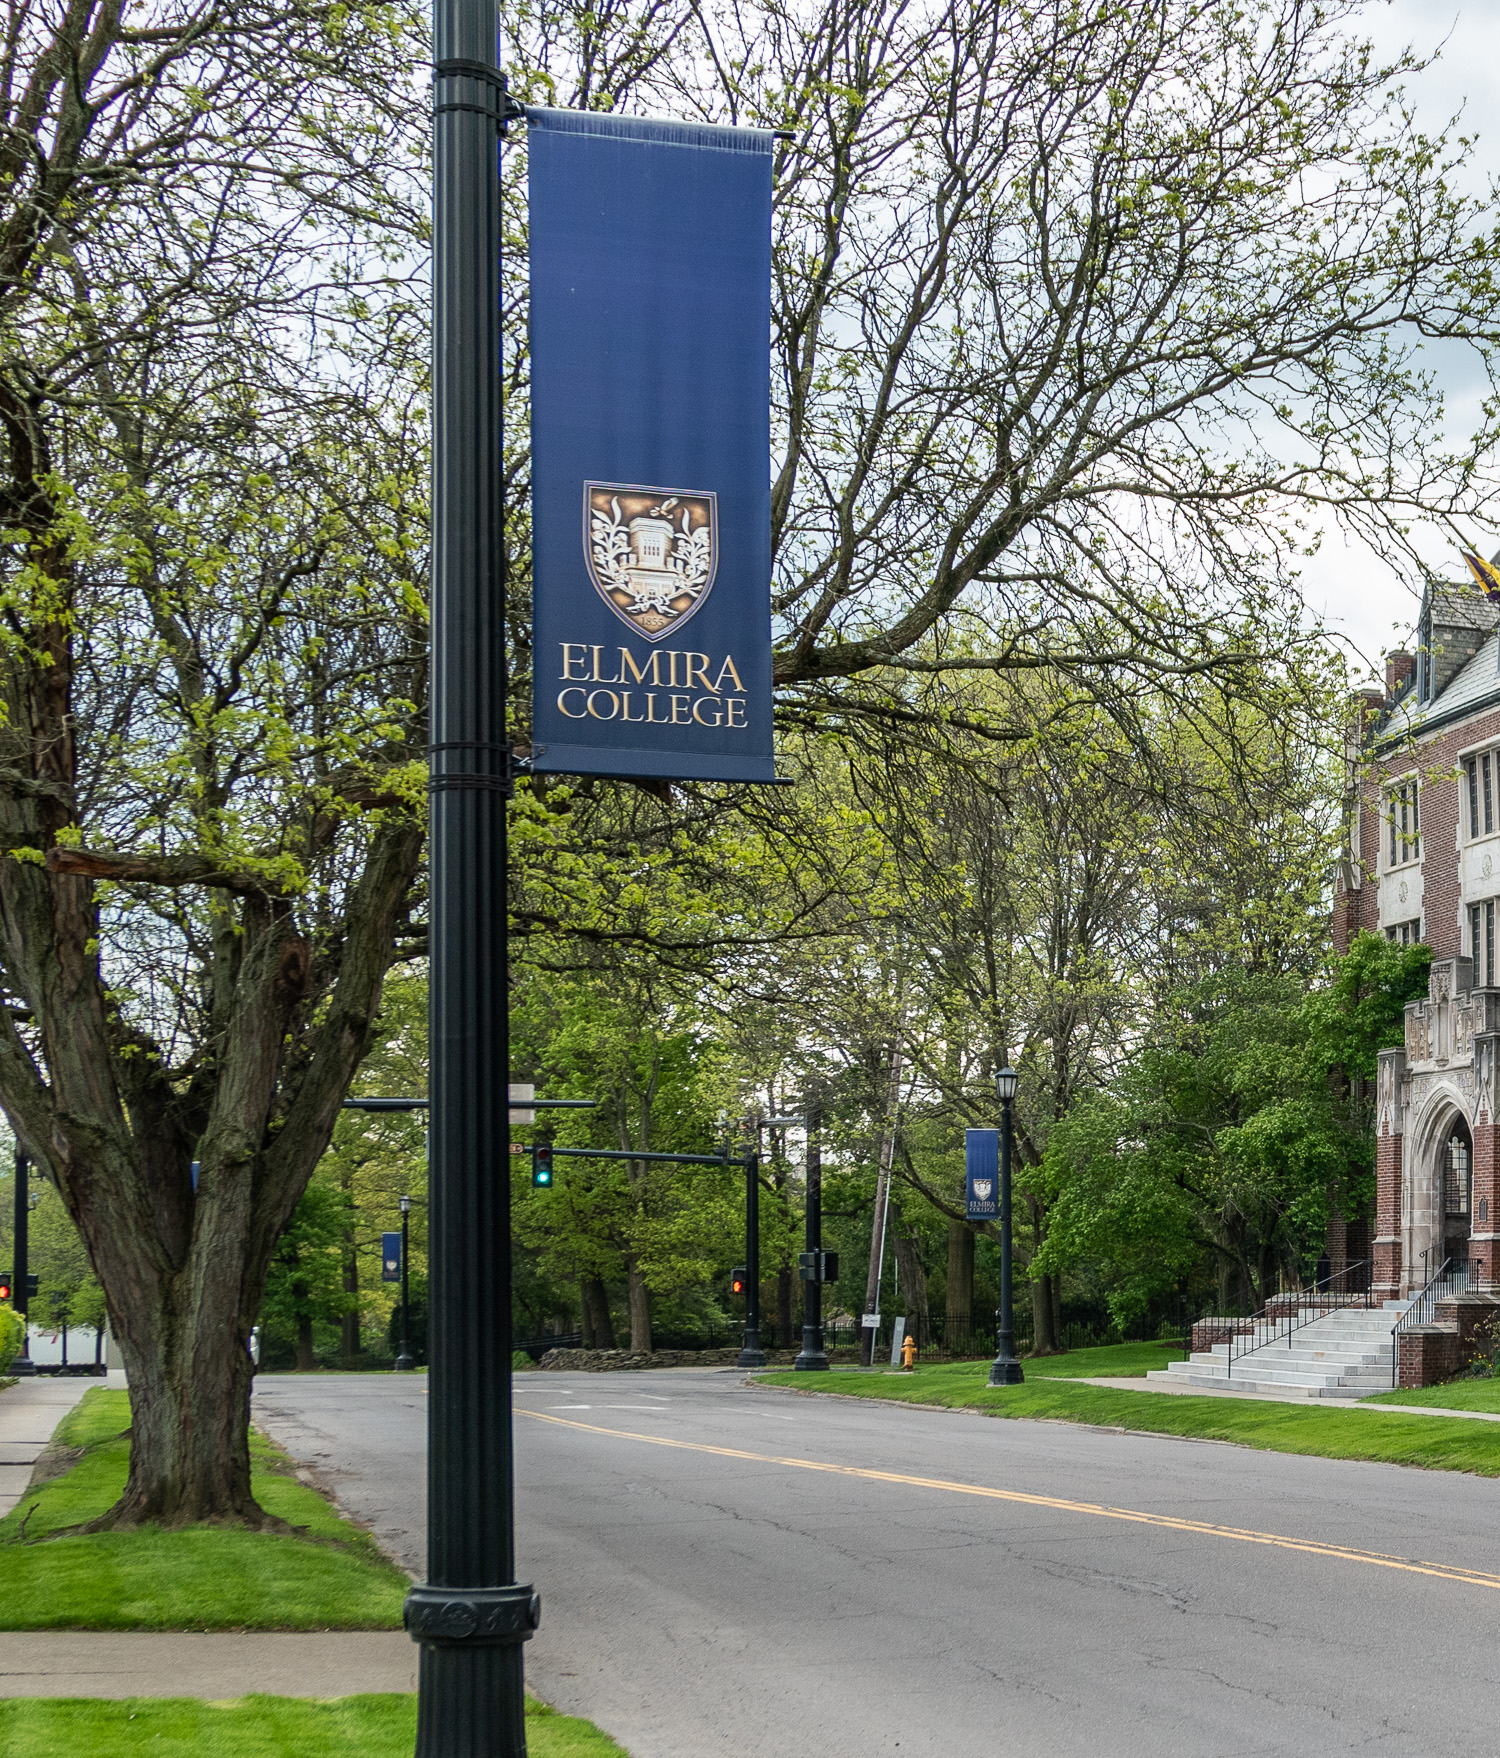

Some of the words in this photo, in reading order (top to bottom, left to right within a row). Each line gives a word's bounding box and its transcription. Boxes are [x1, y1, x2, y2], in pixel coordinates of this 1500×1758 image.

[640, 616, 665, 628] 1855
[558, 642, 748, 694] ELMIRA
[557, 687, 749, 728] COLLEGE
